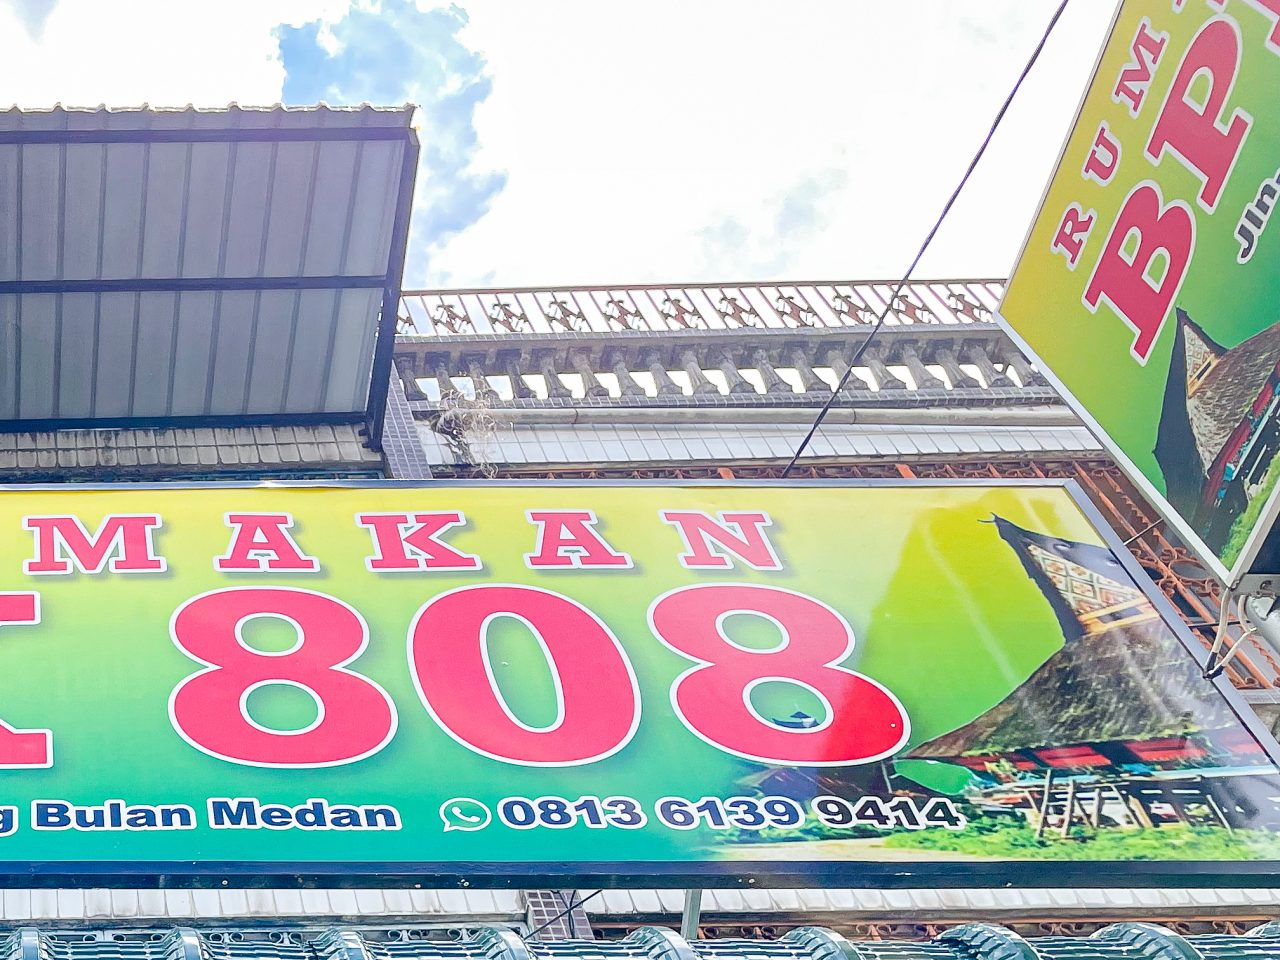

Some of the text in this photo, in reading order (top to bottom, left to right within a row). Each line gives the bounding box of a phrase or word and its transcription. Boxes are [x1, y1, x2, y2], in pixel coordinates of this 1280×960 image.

[1052, 0, 1224, 267] RUM
[1082, 0, 1280, 364] BP
[23, 511, 783, 574] MAKAN
[168, 583, 911, 769] 808
[34, 801, 195, 829] Bulan
[211, 800, 400, 830] Medan
[500, 798, 644, 828] 0813
[657, 798, 803, 829] 6139
[819, 798, 963, 829] 9414
